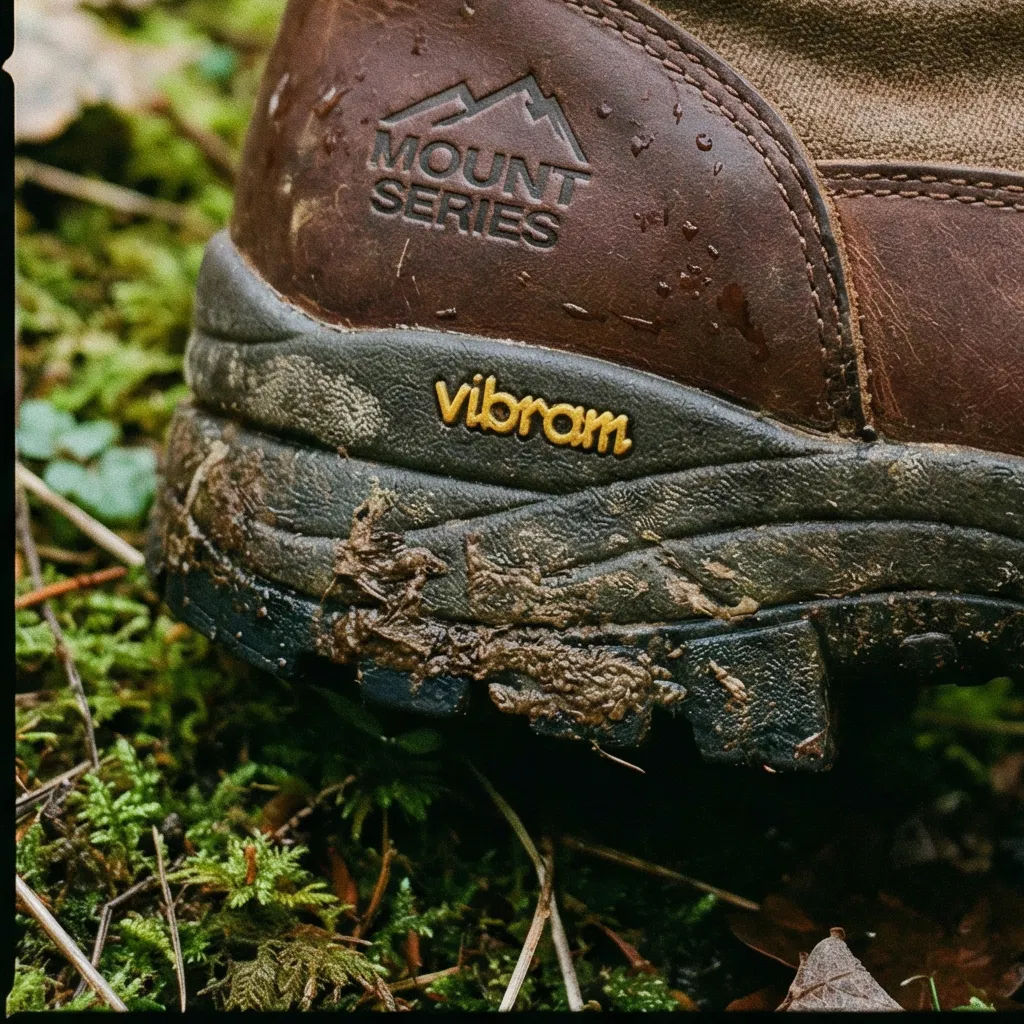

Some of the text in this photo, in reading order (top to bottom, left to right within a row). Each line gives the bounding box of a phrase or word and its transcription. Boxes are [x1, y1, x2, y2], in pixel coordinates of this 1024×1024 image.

[369, 129, 592, 208] MOUNT
[369, 178, 560, 249] SERIES
[435, 373, 633, 455] vibram
